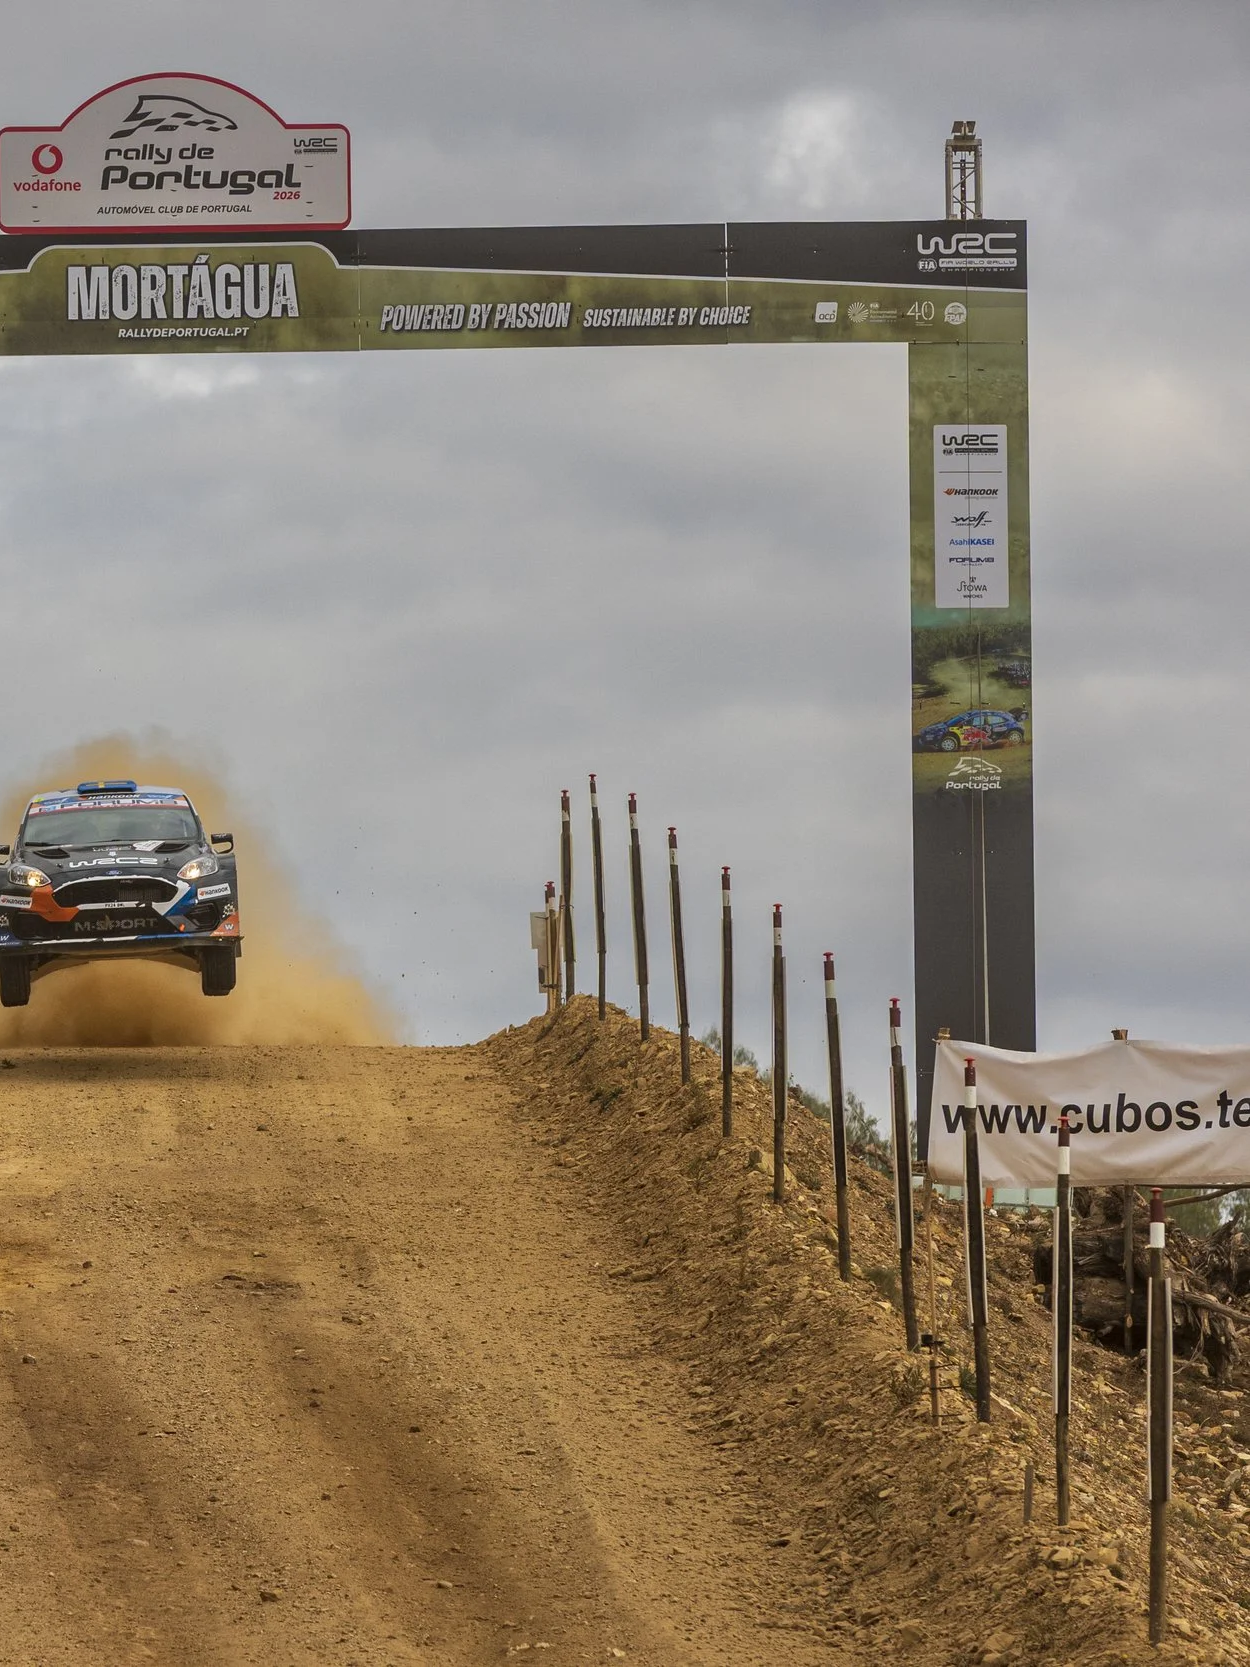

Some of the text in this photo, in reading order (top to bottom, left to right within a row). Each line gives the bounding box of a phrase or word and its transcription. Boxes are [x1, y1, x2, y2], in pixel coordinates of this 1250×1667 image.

[293, 137, 338, 148] WRC
[104, 143, 215, 165] rally de
[100, 163, 302, 195] Portugal
[13, 179, 82, 192] vodafone
[273, 191, 301, 201] 2026
[97, 204, 253, 215] AUTOMÓVEL CLUB DE PORTUGAL
[917, 233, 1017, 254] WRC
[918, 261, 936, 270] FIA
[67, 254, 300, 321] MORTÁGUA
[380, 302, 572, 331] POWERED BY PASSION
[906, 301, 935, 320] 40
[583, 306, 752, 328] SUSTAINABLE BY CHOICE
[118, 327, 250, 338] RALLYDEPORTUGAL.PT
[942, 434, 999, 446] WRC
[969, 774, 989, 783] rally
[945, 781, 1002, 791] Portugal
[69, 857, 158, 868] WRC2
[74, 917, 158, 932] M-SPORT
